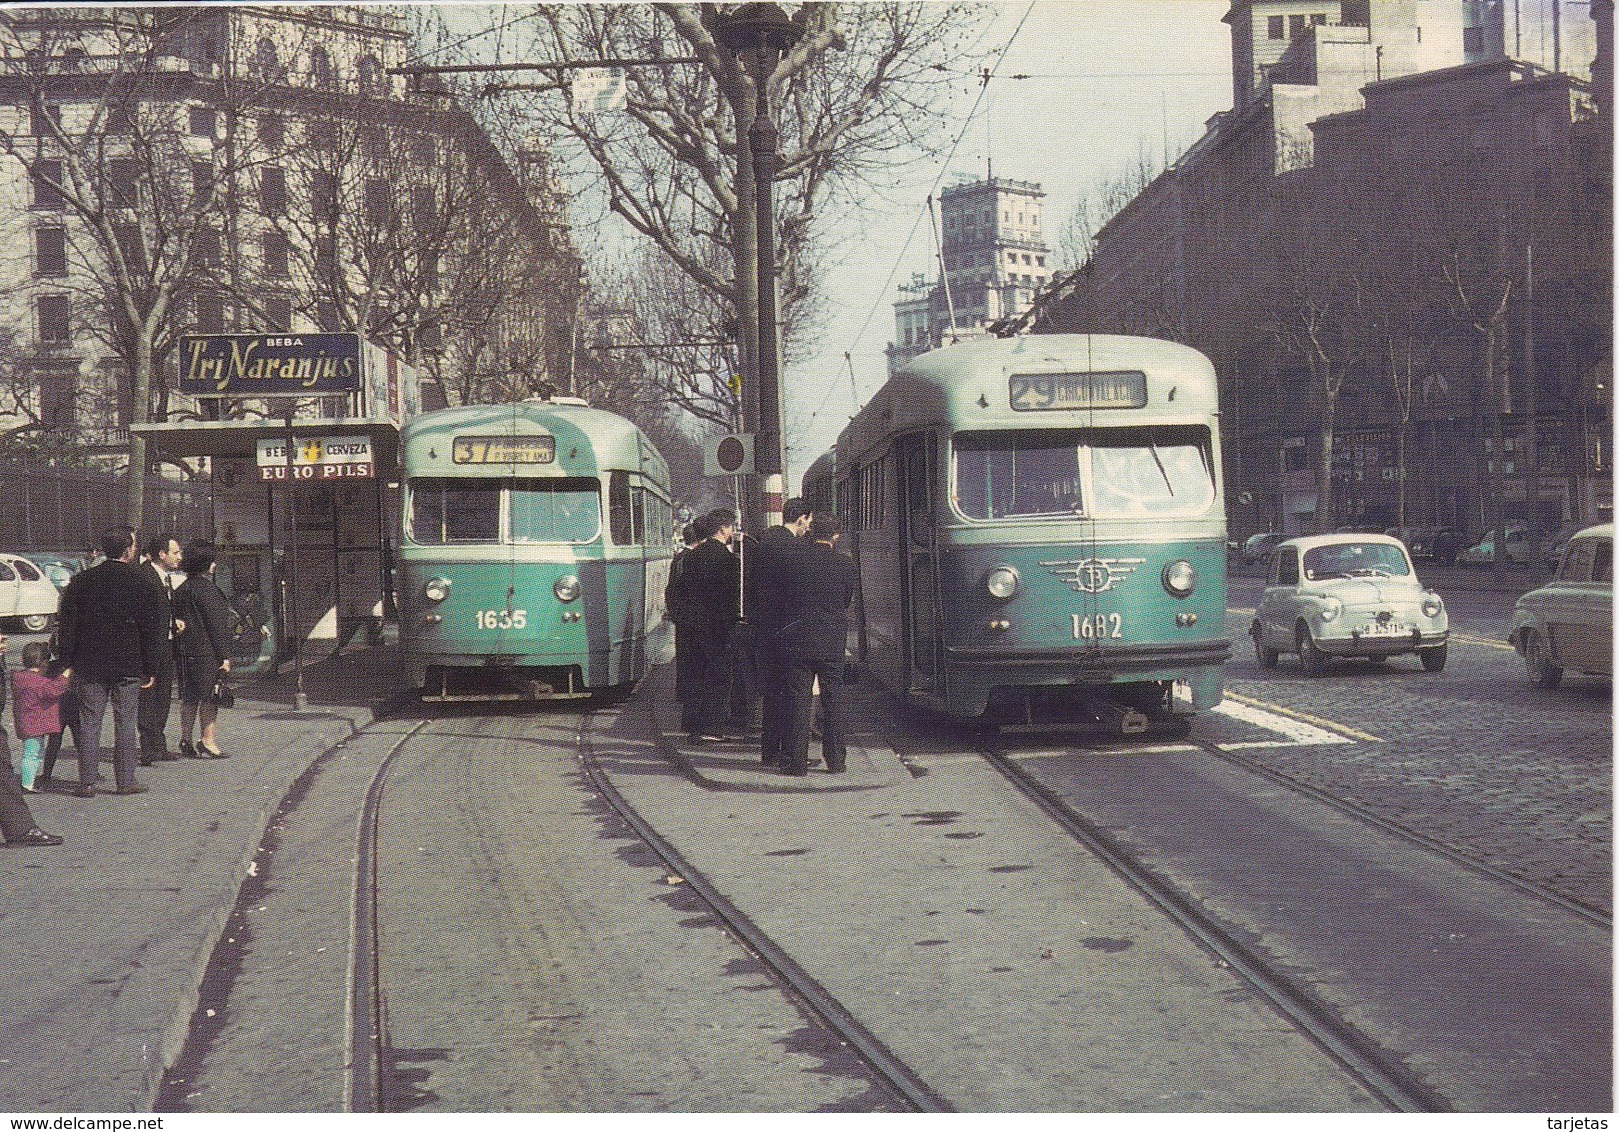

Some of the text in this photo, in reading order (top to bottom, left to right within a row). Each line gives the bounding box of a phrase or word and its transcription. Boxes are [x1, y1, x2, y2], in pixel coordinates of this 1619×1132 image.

[266, 338, 302, 347] BEBA
[1011, 378, 1054, 407] 29
[326, 442, 368, 456] CERVEZA
[455, 438, 492, 462] 37
[323, 464, 368, 478] PILS
[475, 609, 528, 629] 1635
[1072, 612, 1122, 639] 1682
